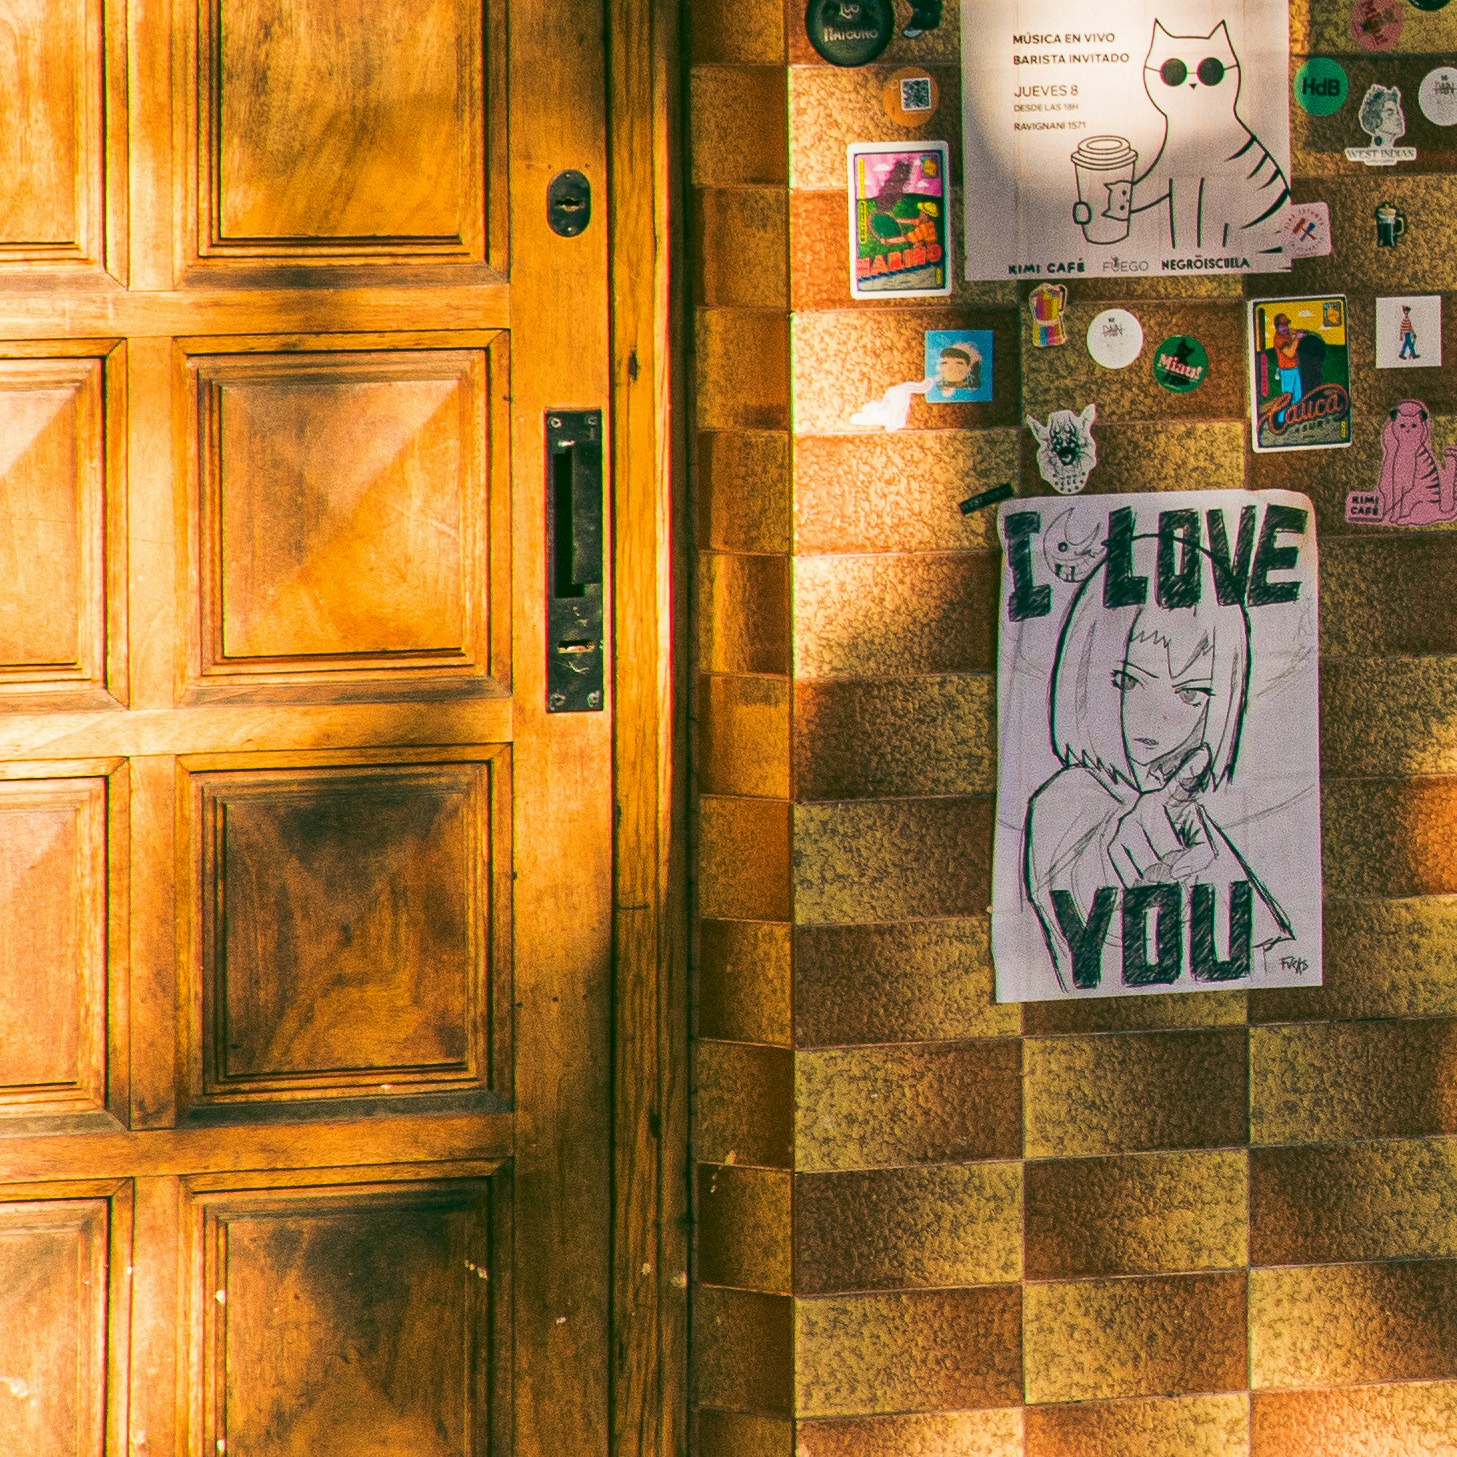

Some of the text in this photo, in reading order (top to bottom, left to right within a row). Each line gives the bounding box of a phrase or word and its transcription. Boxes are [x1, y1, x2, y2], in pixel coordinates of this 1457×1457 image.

[1012, 31, 1115, 45] MÚSICA EN VIVO
[1013, 53, 1130, 65] BARISTA INVITADO
[1014, 84, 1078, 97] JUEVES 8
[1302, 78, 1341, 97] HdB
[1014, 103, 1043, 113] DESDE
[1044, 103, 1061, 111] LAS
[1014, 122, 1066, 131] RAVIGNANI
[1347, 149, 1376, 159] WEST
[1008, 263, 1041, 275] KIMI
[1047, 257, 1086, 273] CAFÉ
[1103, 258, 1149, 273] FUEGO
[1260, 388, 1346, 434] Cauca
[1352, 495, 1379, 504] KIMI
[1004, 504, 1308, 622] I LOVE
[1050, 880, 1253, 989] YOU
